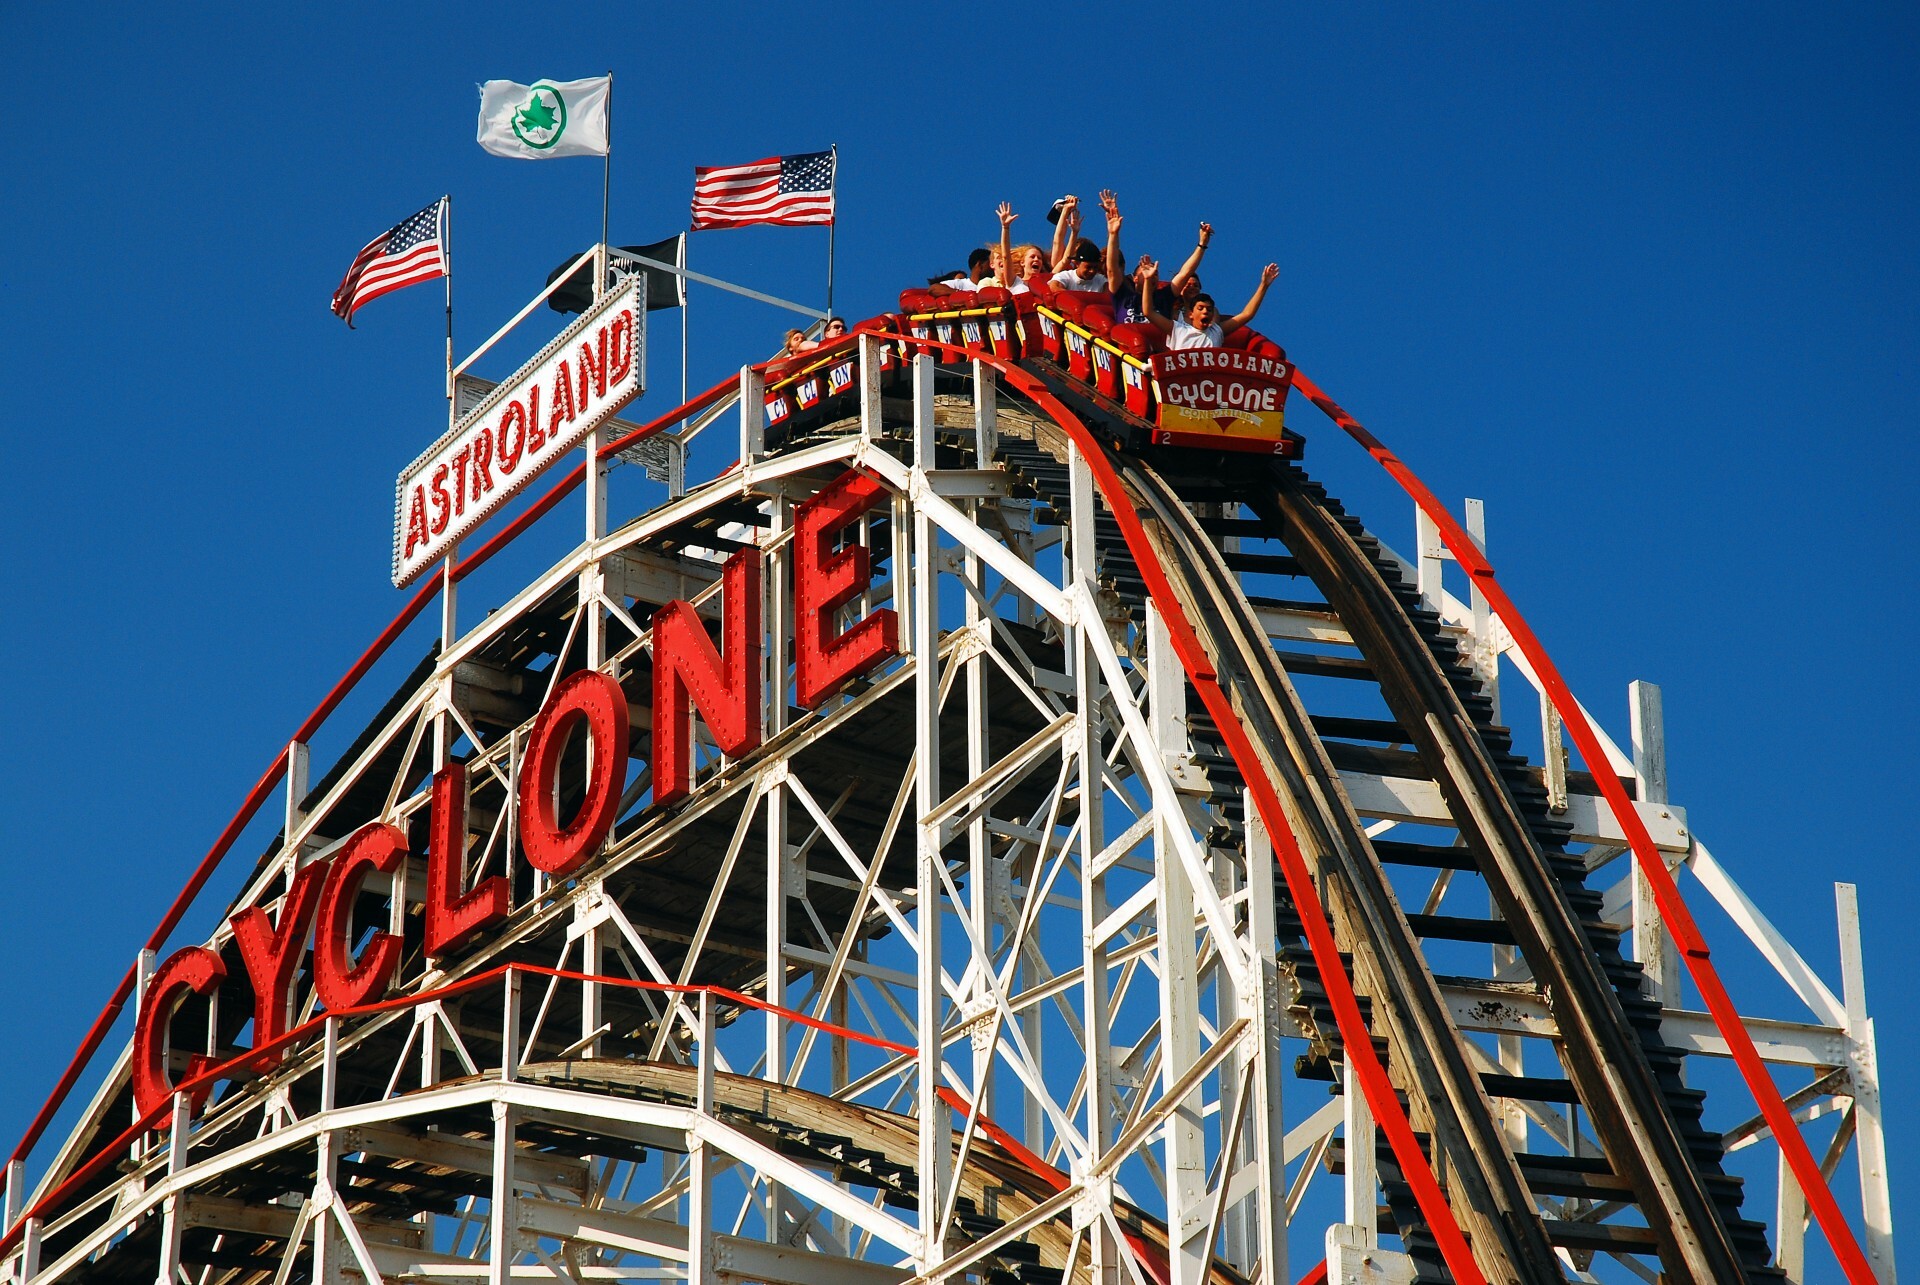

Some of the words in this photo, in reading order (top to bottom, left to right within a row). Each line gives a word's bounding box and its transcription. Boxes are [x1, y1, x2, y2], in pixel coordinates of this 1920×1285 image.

[1165, 351, 1287, 379] ASTROLAND
[1167, 379, 1278, 412] CYCLONE
[404, 308, 632, 560] ASTROLAND
[1162, 432, 1171, 445] 2
[1274, 442, 1283, 455] 2
[131, 469, 900, 1131] CYCLONE
